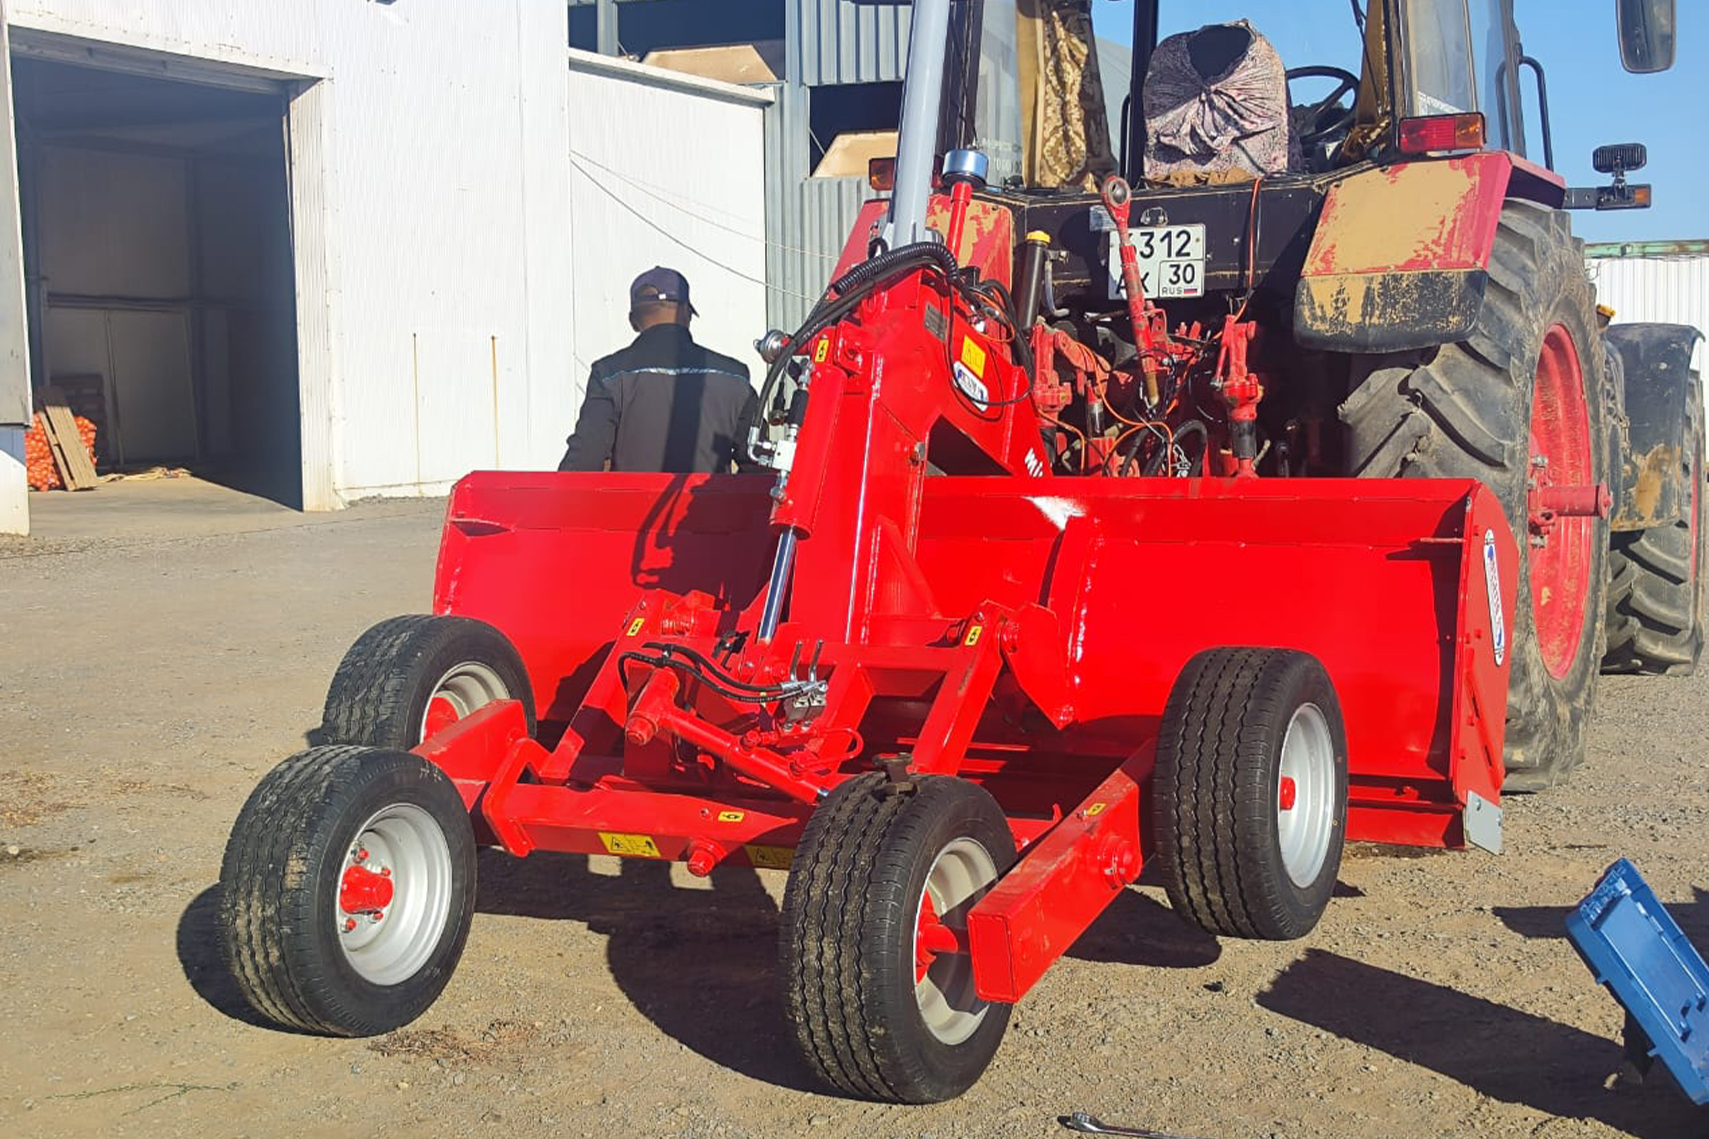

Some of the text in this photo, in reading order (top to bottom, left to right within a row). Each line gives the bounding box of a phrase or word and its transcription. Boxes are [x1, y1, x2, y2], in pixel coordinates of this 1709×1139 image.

[1126, 229, 1191, 259] 312
[1168, 263, 1195, 285] 30
[1161, 286, 1183, 296] RUS
